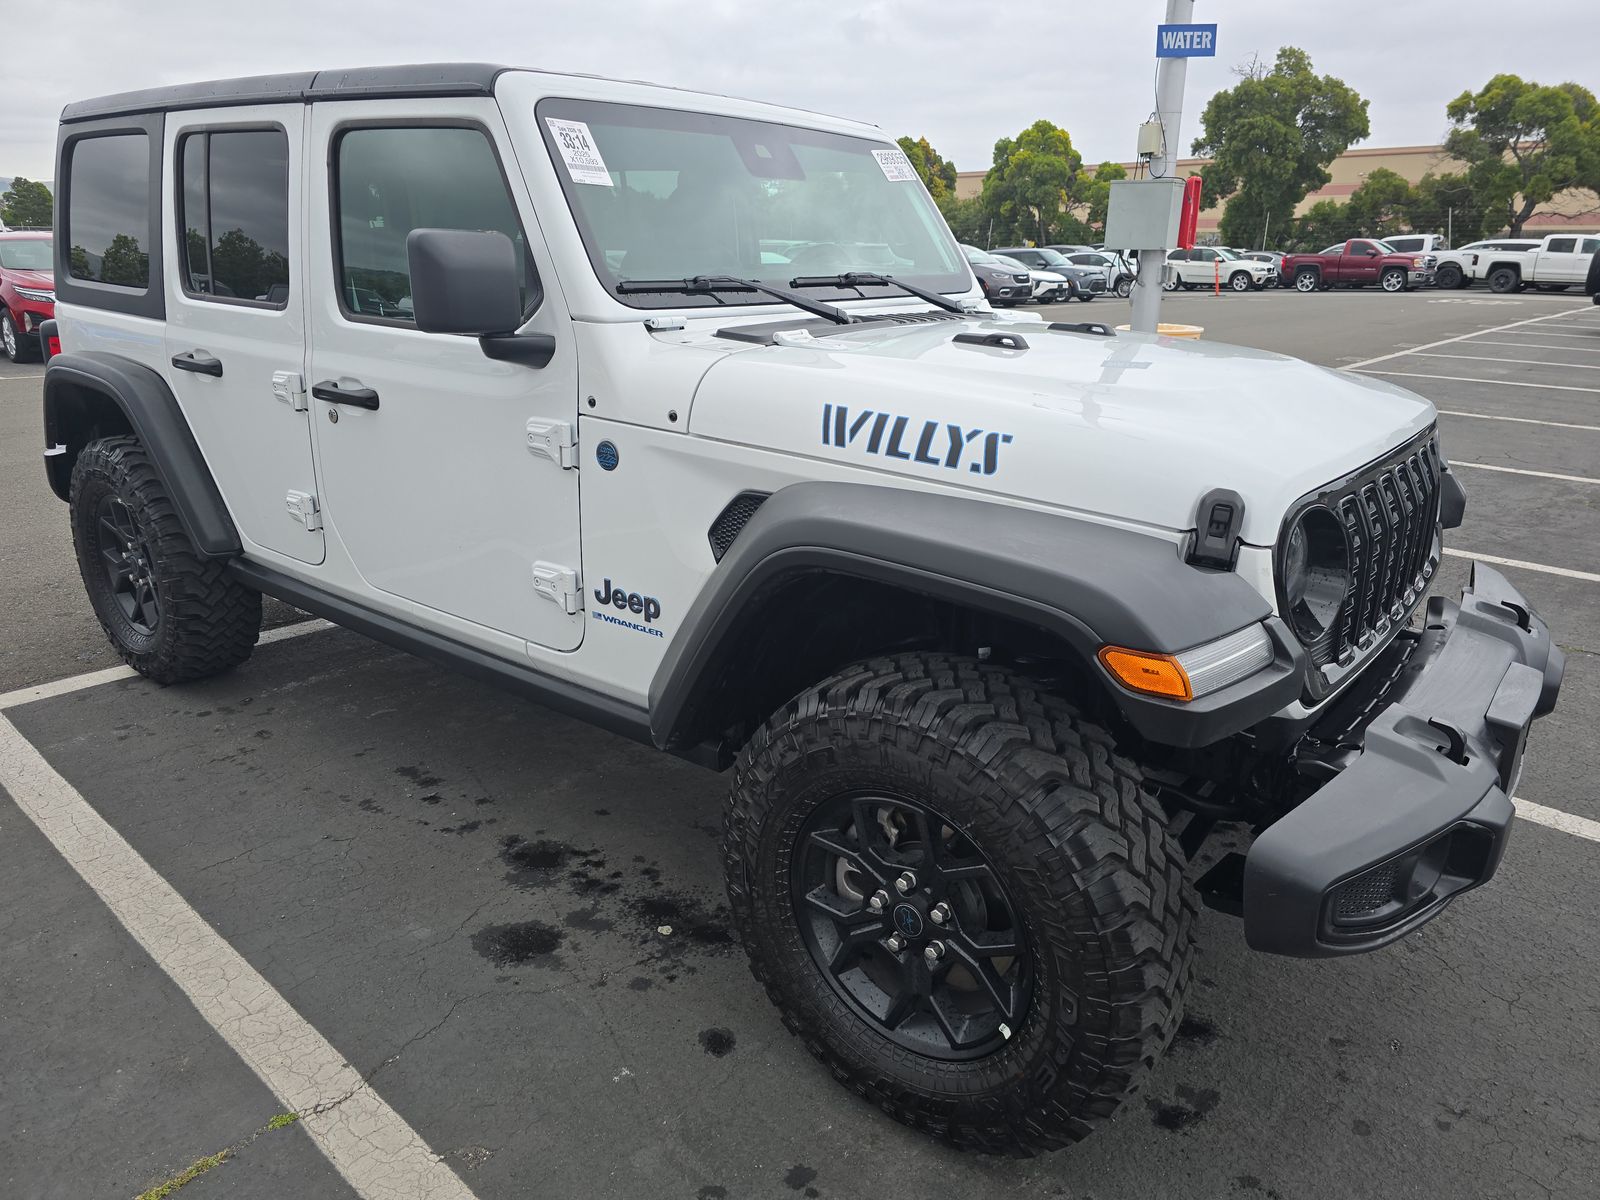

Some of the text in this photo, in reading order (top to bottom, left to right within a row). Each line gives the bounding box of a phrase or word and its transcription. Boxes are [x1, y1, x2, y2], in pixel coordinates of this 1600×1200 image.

[1162, 31, 1212, 49] WATER
[560, 132, 590, 151] 33:14
[822, 403, 1014, 476] WILLYS
[594, 577, 661, 623] Jeep
[602, 614, 664, 638] WRANGLER
